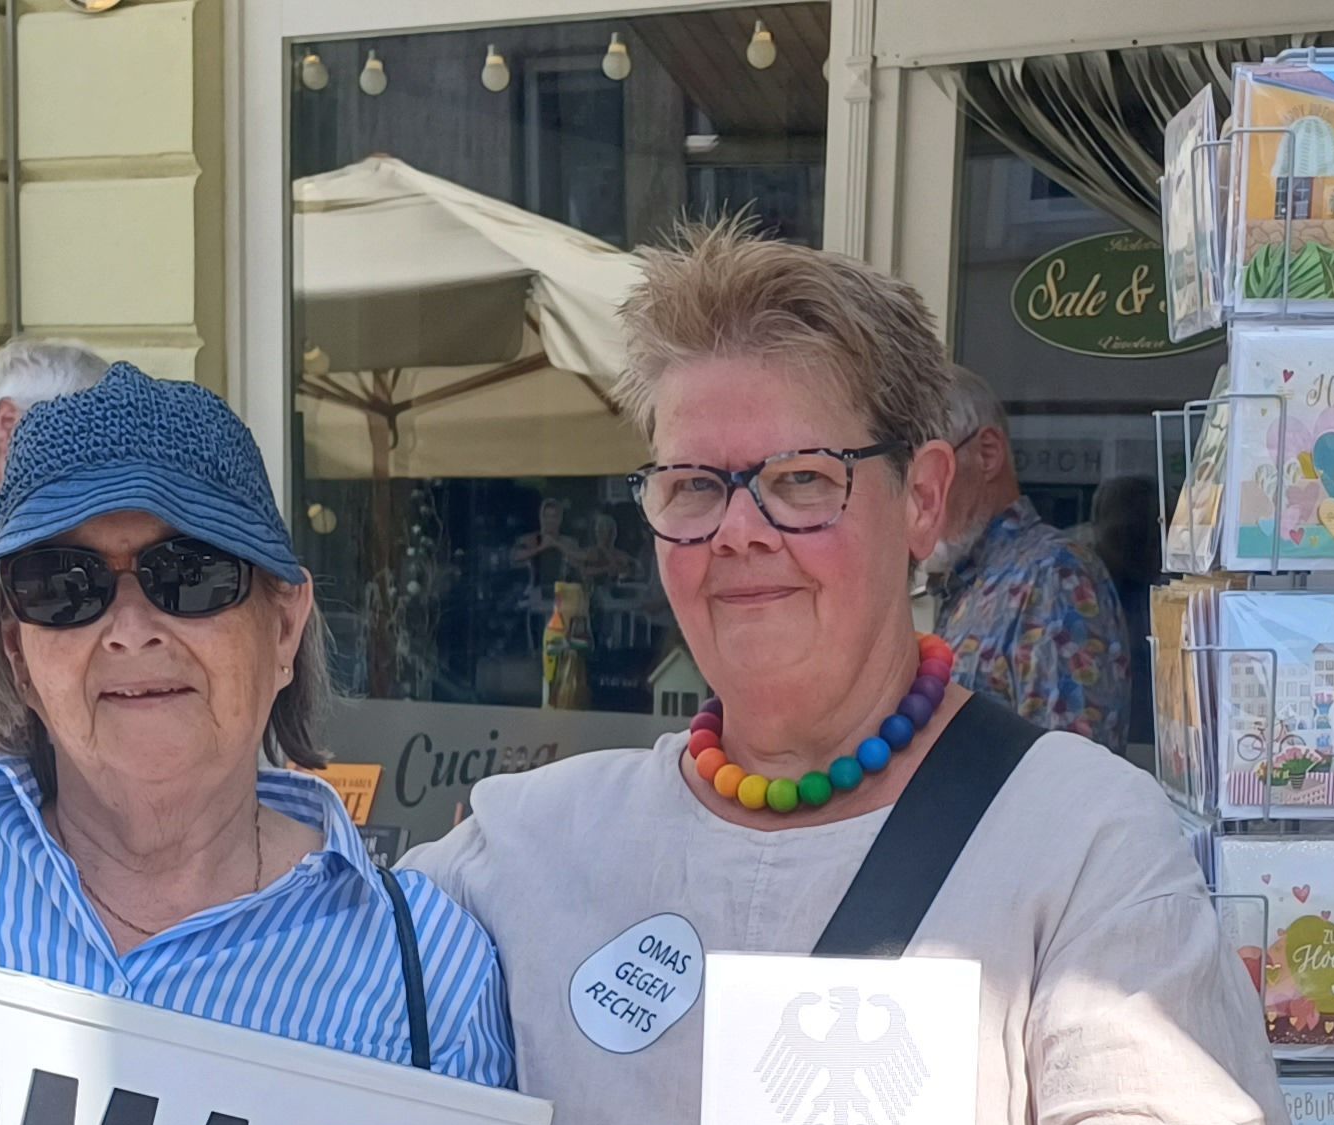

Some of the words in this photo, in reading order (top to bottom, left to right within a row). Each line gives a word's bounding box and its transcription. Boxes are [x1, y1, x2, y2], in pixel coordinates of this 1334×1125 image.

[1027, 258, 1108, 321] Sale
[1115, 264, 1156, 316] &
[637, 934, 692, 975] OMAS
[614, 961, 676, 1003] GEGEN
[585, 980, 657, 1033] RECHTS
